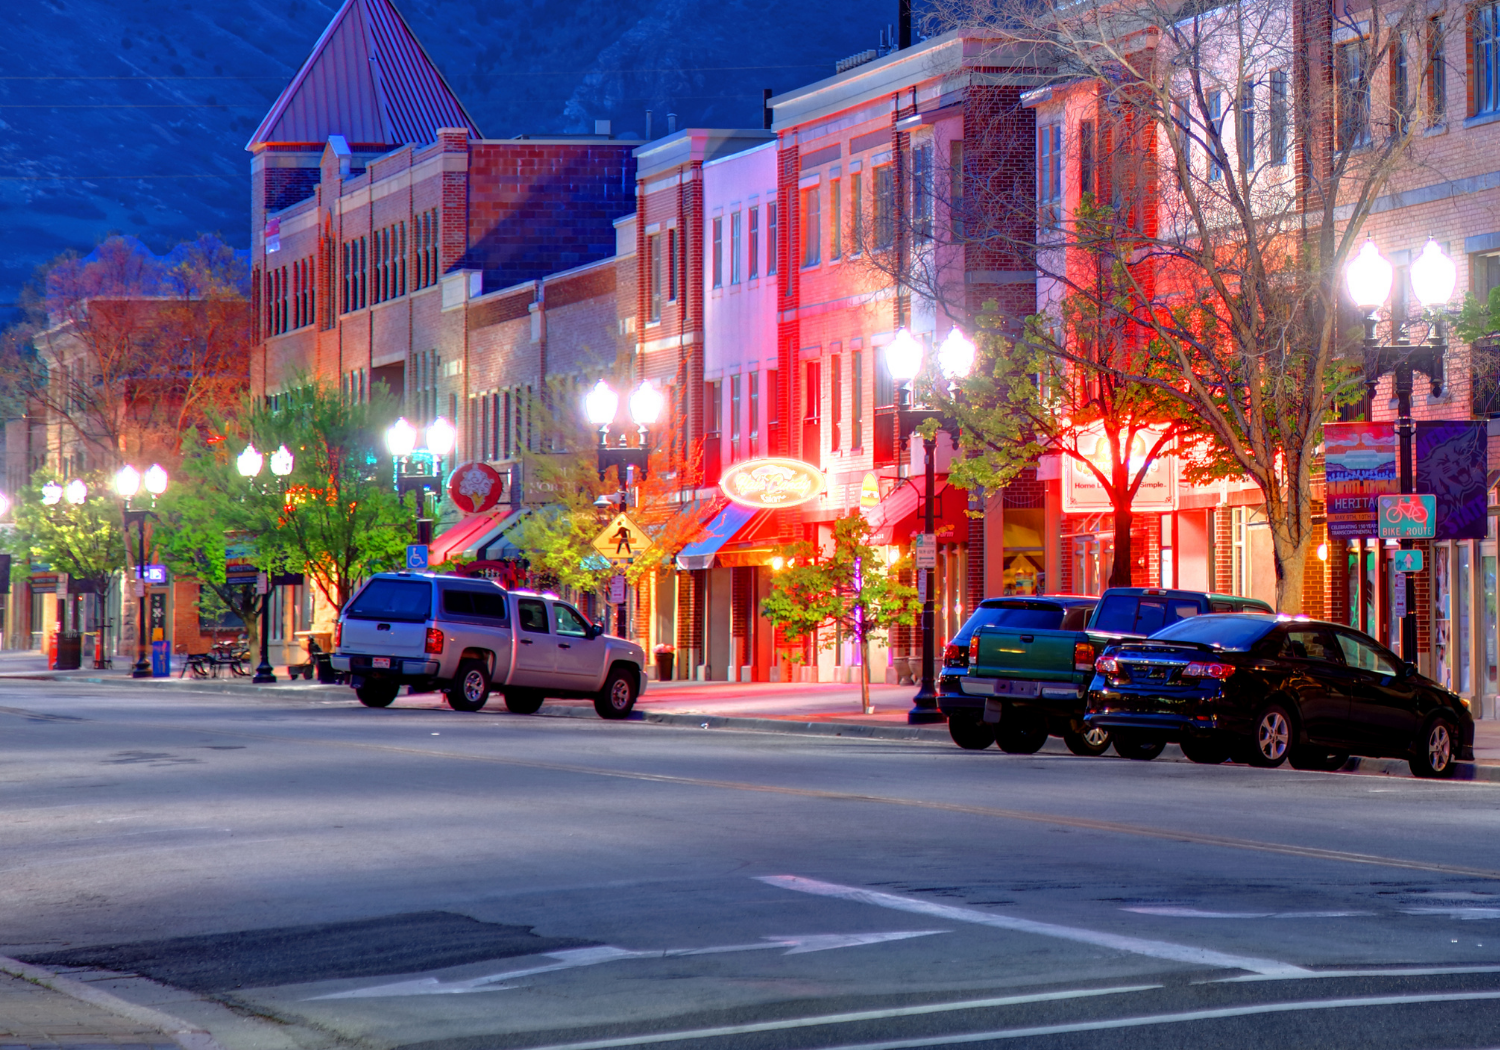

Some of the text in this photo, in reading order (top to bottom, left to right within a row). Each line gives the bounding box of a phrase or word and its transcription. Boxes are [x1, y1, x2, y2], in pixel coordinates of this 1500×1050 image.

[1334, 497, 1378, 510] HERITA
[1444, 494, 1487, 534] STATE
[1382, 527, 1401, 536] BIKE
[1406, 526, 1432, 536] ROUTE
